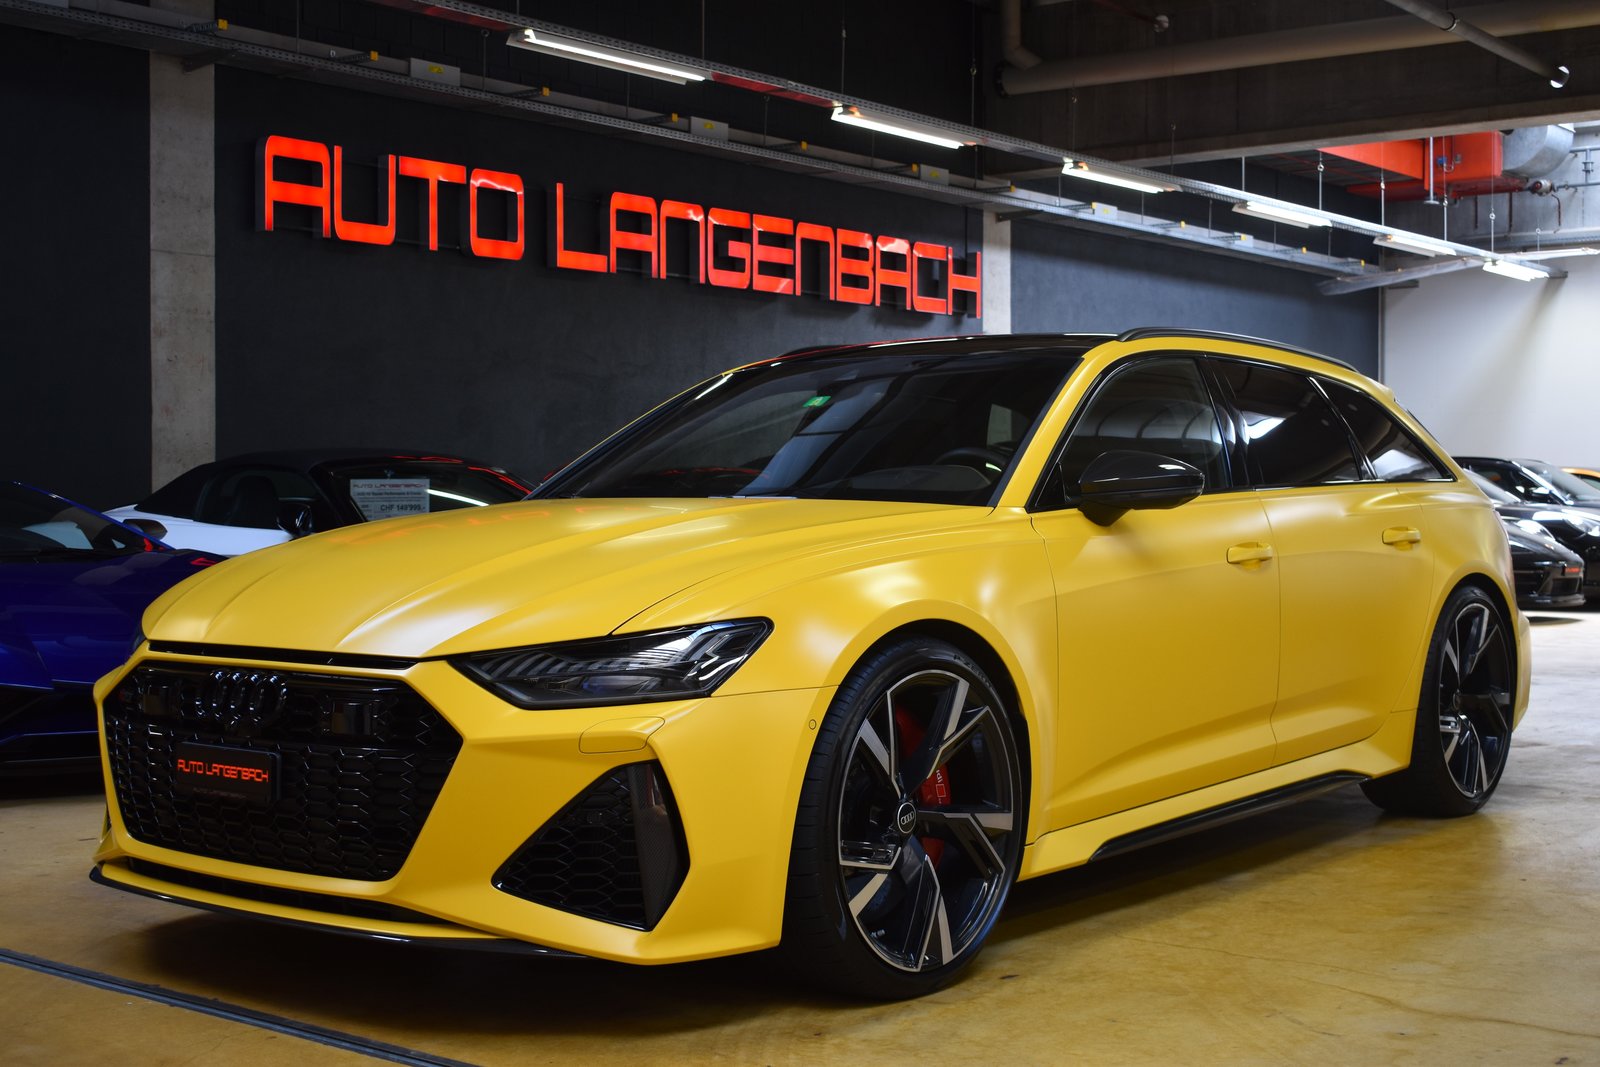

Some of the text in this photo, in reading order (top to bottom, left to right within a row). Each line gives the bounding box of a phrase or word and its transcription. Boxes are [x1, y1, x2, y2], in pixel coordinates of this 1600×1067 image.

[264, 135, 982, 319] AUTO LANGENBACH
[177, 759, 269, 782] AUTO LANGENBACH
